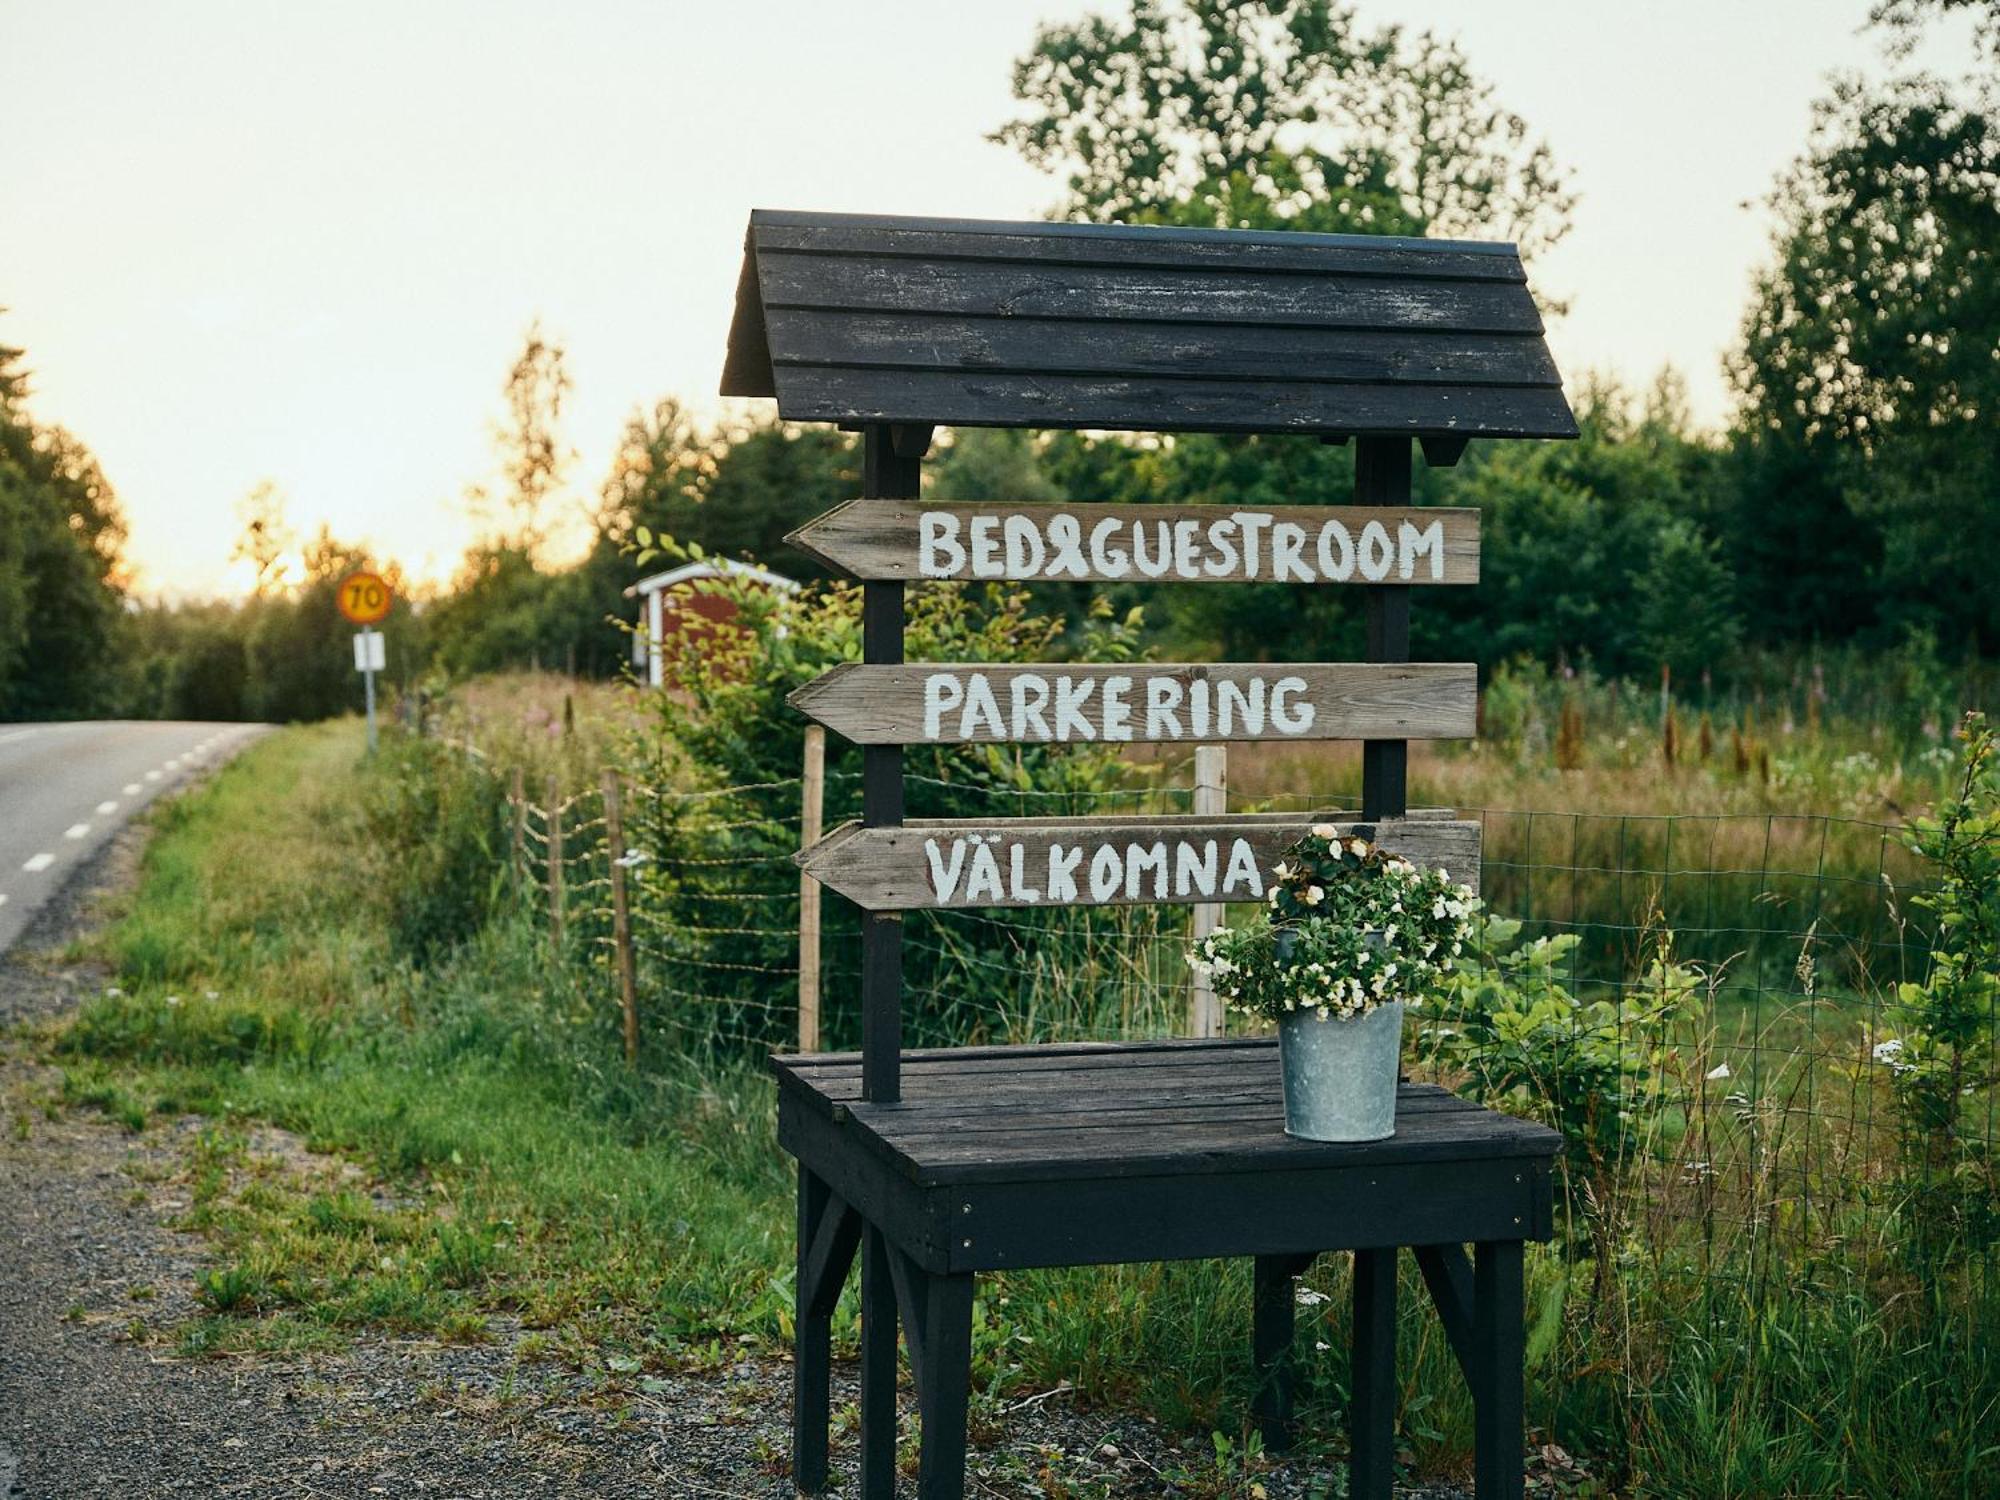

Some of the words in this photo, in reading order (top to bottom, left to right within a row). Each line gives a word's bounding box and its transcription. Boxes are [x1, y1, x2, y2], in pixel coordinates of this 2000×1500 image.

[349, 584, 384, 609] 70
[923, 673, 1316, 742] PARKERING
[924, 834, 1263, 905] VÄLKOMNA
